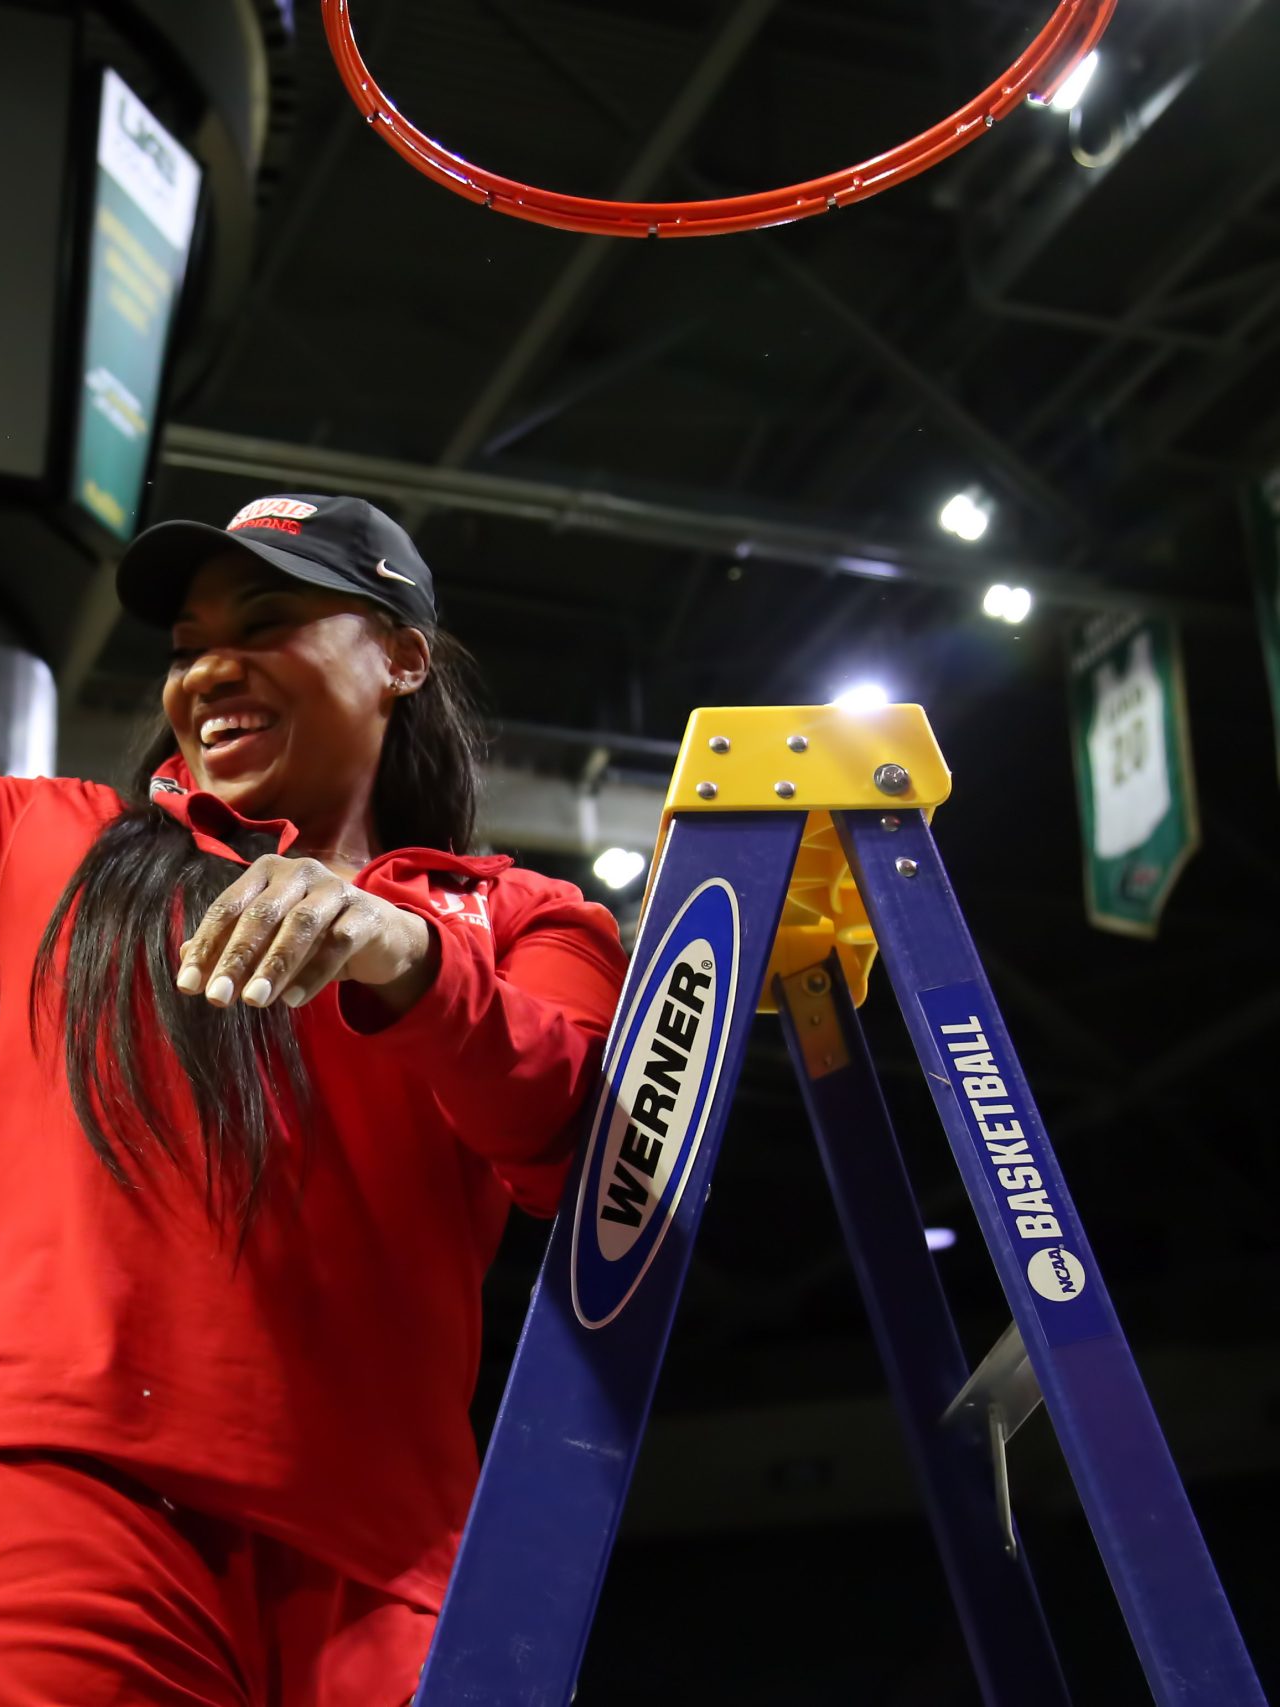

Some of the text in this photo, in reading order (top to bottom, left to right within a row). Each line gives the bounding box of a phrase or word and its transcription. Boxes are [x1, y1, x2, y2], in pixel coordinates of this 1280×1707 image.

[601, 960, 712, 1228] WERNER
[940, 1015, 1076, 1294] NCAA BASKETBALL
